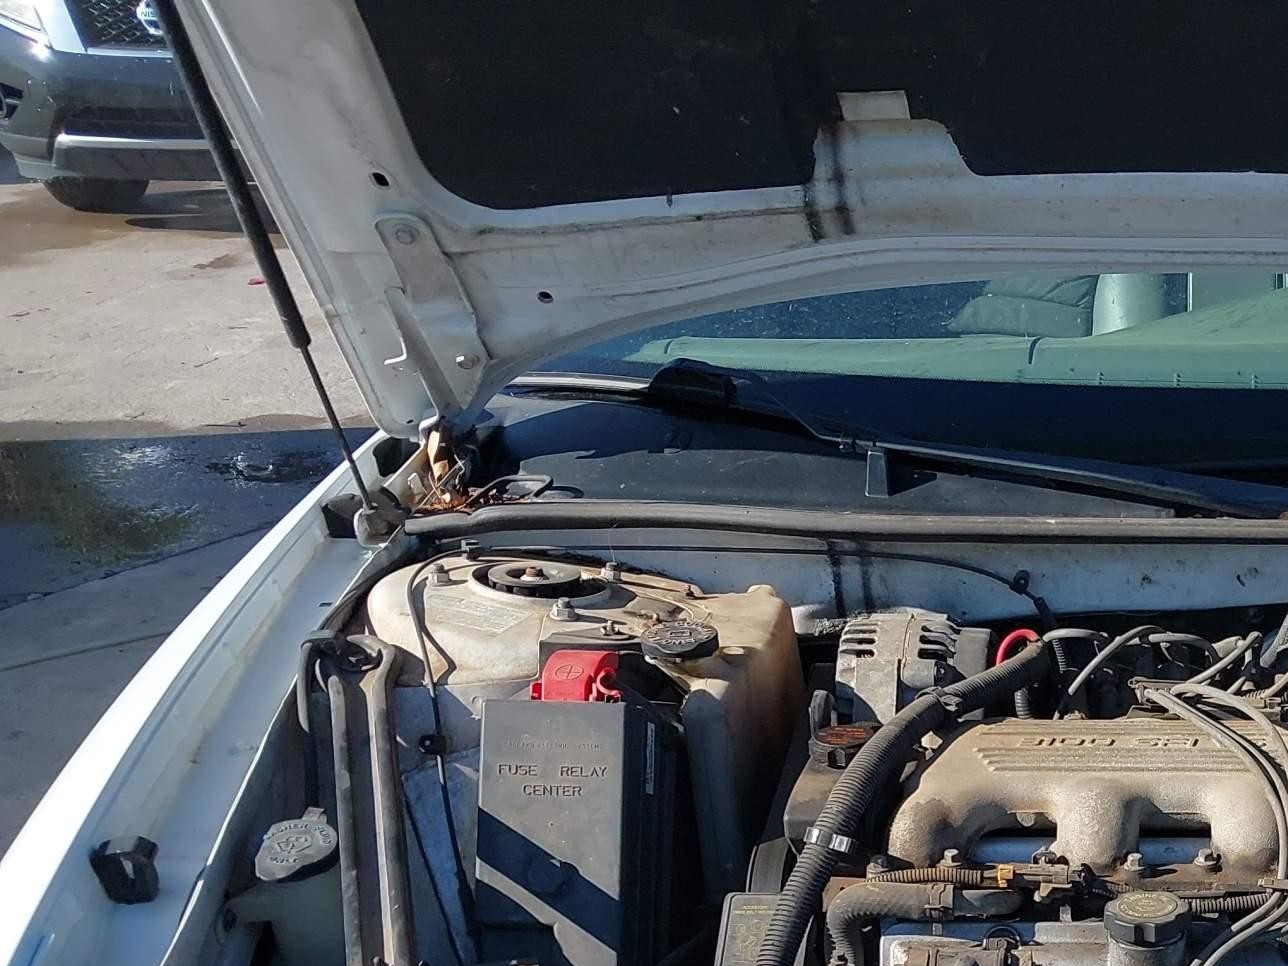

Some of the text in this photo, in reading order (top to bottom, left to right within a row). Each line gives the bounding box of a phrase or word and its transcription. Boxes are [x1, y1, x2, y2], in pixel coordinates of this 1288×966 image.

[498, 764, 608, 778] FUSE RELAY
[522, 784, 583, 798] CENTER
